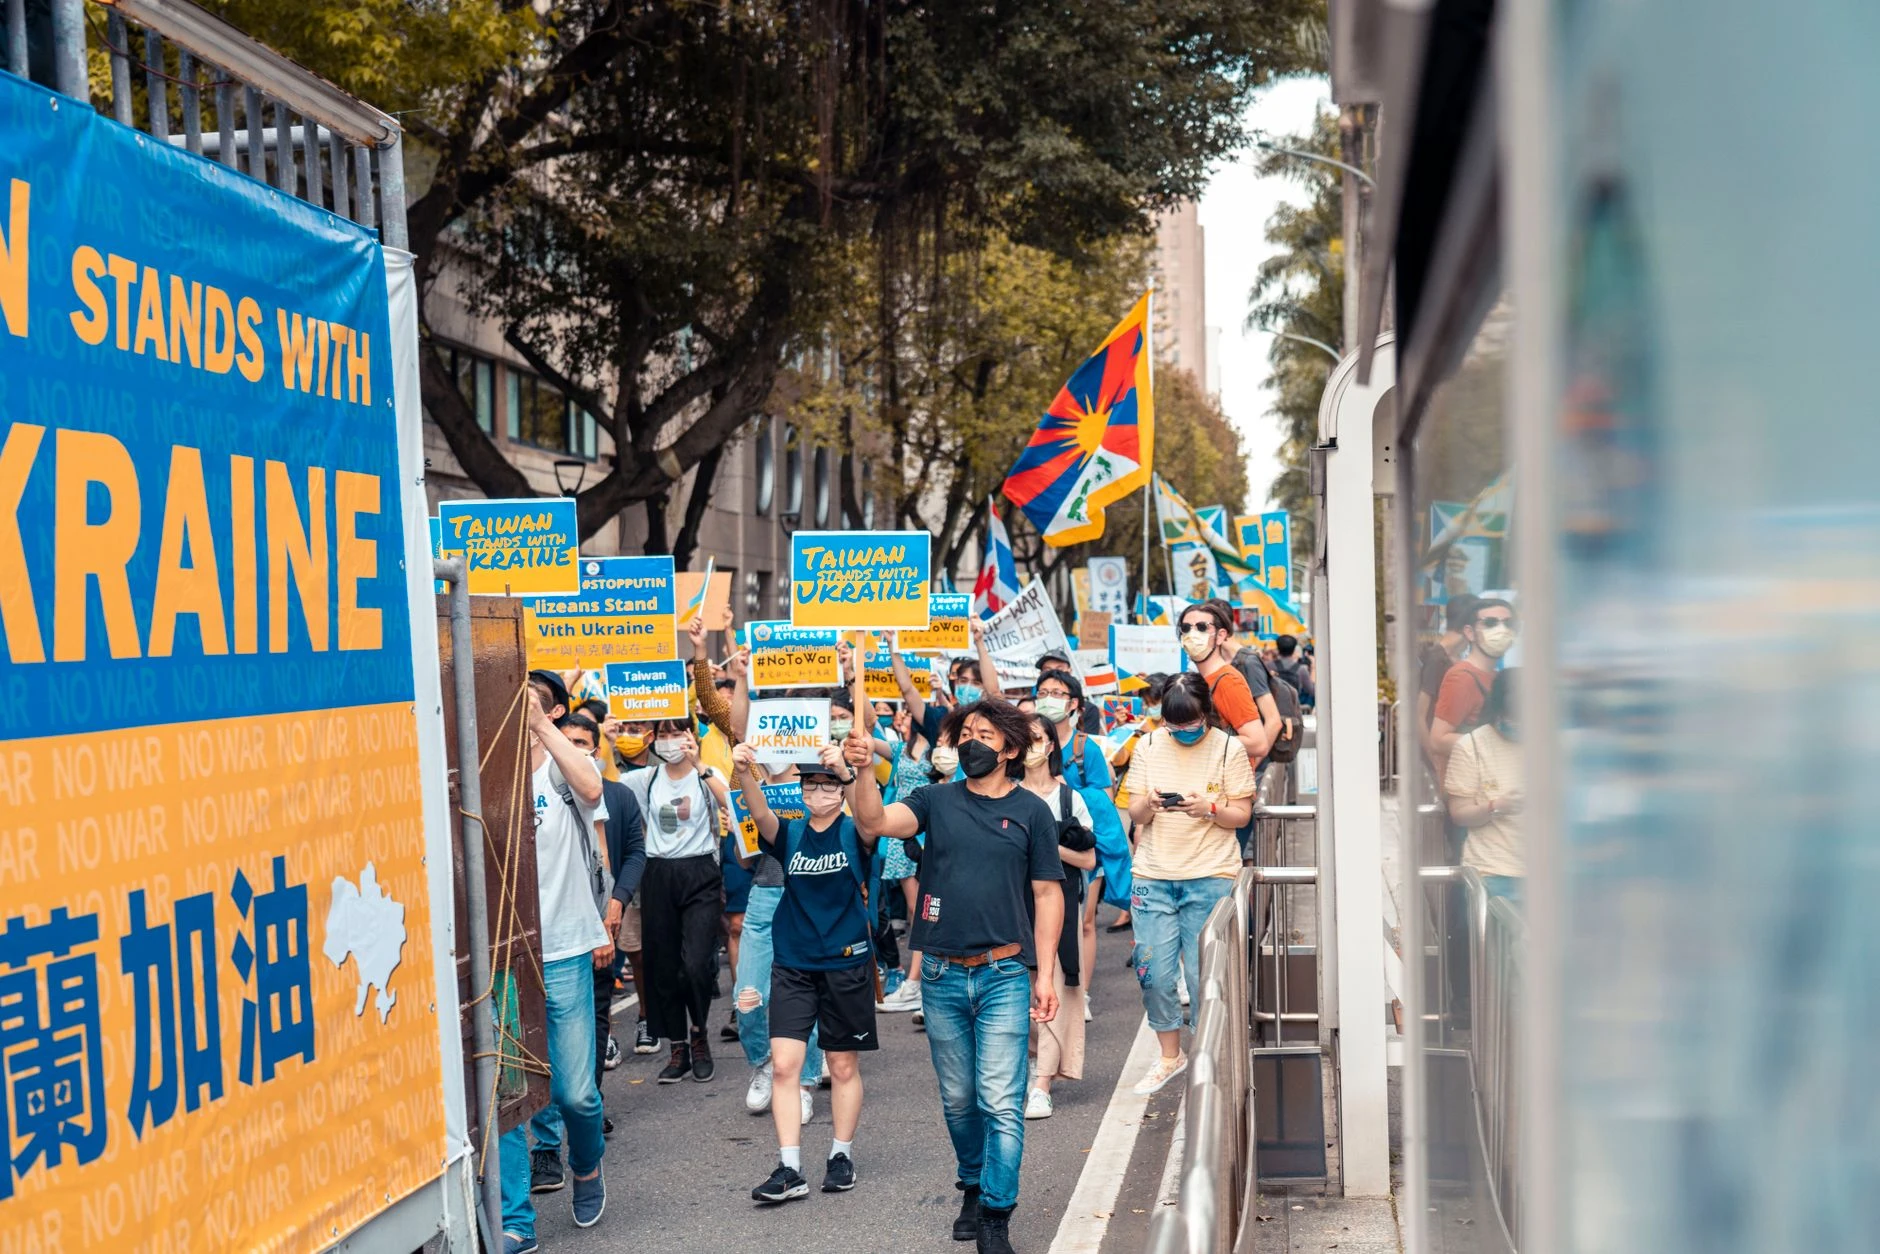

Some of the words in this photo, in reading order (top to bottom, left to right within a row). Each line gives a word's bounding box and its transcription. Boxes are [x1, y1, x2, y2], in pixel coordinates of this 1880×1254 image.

[69, 244, 264, 382] STANDS
[277, 308, 372, 406] WITH
[77, 381, 138, 441] WAR
[449, 512, 553, 539] TAIWAN
[0, 422, 383, 664] KRAINE
[466, 536, 523, 549] STANDS
[527, 533, 567, 546] WITH
[463, 547, 571, 572] KRAINE
[801, 544, 906, 571] TAIWAN
[581, 577, 667, 590] #STOPPUTIN
[816, 568, 876, 582] STANDS
[878, 566, 918, 580] WITH
[535, 599, 600, 614] lizeans
[604, 596, 658, 613] Stand
[796, 580, 922, 605] UKRAINE
[581, 621, 655, 637] Ukraine
[536, 641, 670, 657] 與烏克蘭站在一起
[757, 652, 832, 667] #NoToWar
[623, 670, 667, 682] Taiwan
[0, 673, 32, 729] AR
[48, 669, 92, 724] NO
[97, 665, 159, 720] WAR
[172, 663, 210, 712] NO
[211, 661, 261, 706] WAR
[272, 659, 301, 701] NO
[610, 685, 651, 697] Stands
[654, 682, 682, 696] with
[623, 697, 670, 710] Ukraine
[758, 715, 818, 730] STAND
[775, 726, 798, 737] with
[751, 735, 823, 748] UKRAINE
[0, 750, 37, 807] AR
[52, 744, 98, 801] NO
[101, 735, 166, 793] WAR
[177, 730, 216, 781] NO
[217, 725, 268, 774] WAR
[276, 721, 309, 765] NO
[309, 716, 350, 761] WAR
[357, 712, 382, 755] NO
[0, 827, 41, 886] AR
[56, 816, 101, 876] NO
[104, 804, 171, 865] WAR
[181, 796, 220, 849] NO
[221, 788, 272, 840] WAR
[281, 780, 310, 828] NO
[311, 773, 353, 821] WAR
[360, 768, 386, 811] NO
[316, 831, 358, 881] WAR
[363, 822, 389, 864] NO
[0, 854, 317, 1203] 蘭加油
[129, 1149, 190, 1224] WAR
[200, 1125, 236, 1185] NO
[238, 1100, 288, 1165] WAR
[296, 1080, 327, 1136] NO
[328, 1060, 373, 1118] WAR
[377, 1045, 404, 1093] NO
[203, 1189, 240, 1253] NO
[242, 1162, 293, 1228] WAR
[300, 1140, 332, 1197] NO
[331, 1118, 376, 1177] WAR
[383, 1098, 410, 1149] NO
[81, 1183, 125, 1250] NO
